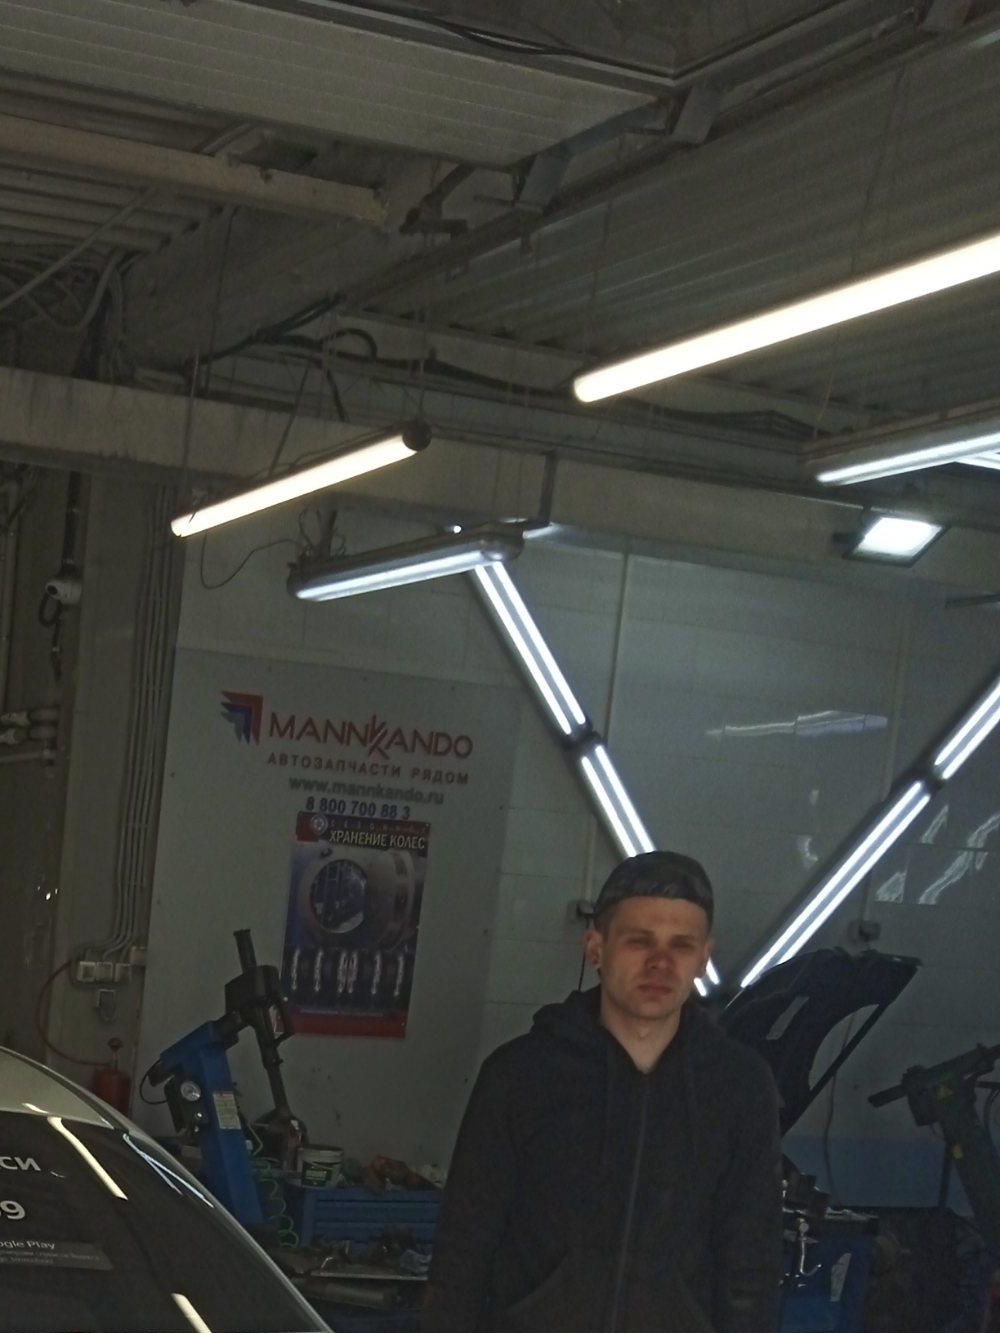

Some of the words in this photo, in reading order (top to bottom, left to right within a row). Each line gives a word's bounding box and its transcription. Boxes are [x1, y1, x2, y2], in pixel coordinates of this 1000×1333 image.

[269, 712, 475, 760] MANNKANDO
[268, 752, 402, 776] АВТОЗАПЧАСТИ
[411, 767, 469, 785] РЯДОМ
[289, 776, 444, 806] www.mannkando.ru
[305, 796, 315, 811] 8
[319, 798, 346, 814] 800
[351, 801, 376, 817] 700
[380, 804, 398, 819] 88
[329, 830, 387, 847] ХРАНЕНИЕ
[390, 835, 426, 849] КОЛЕС
[26, 1239, 56, 1250] Play
